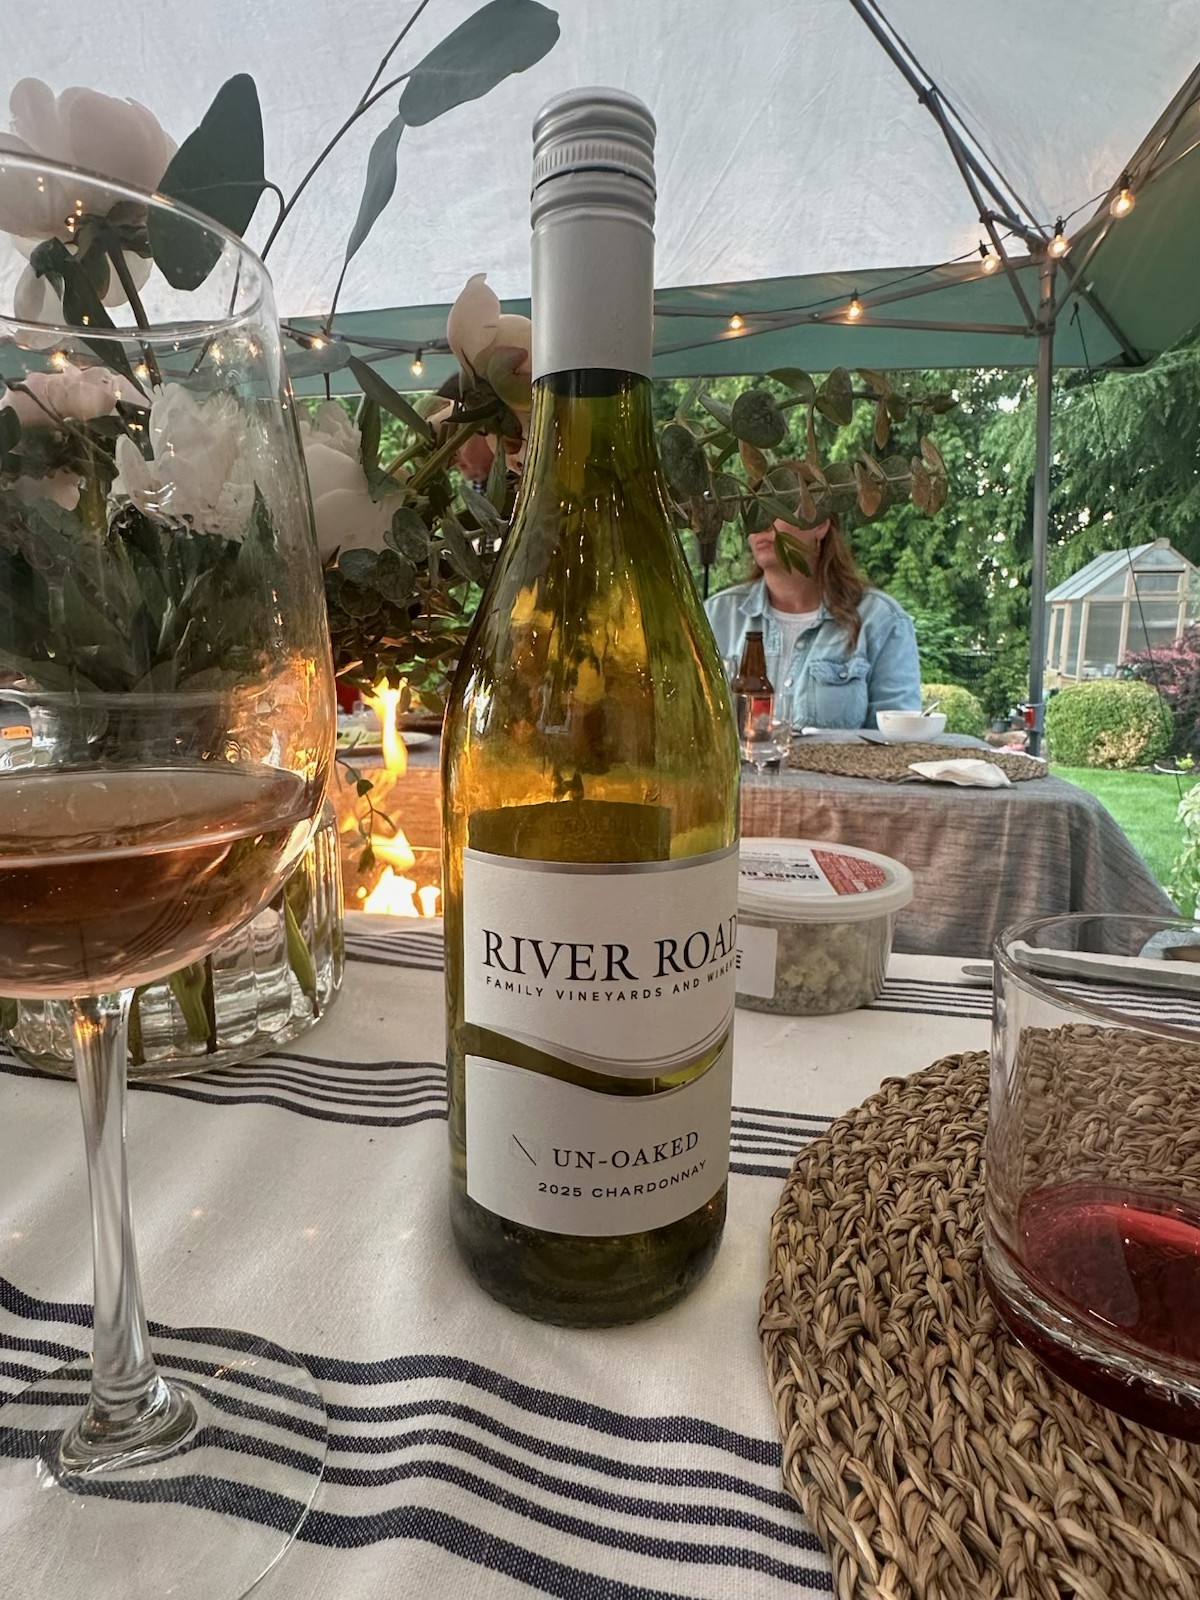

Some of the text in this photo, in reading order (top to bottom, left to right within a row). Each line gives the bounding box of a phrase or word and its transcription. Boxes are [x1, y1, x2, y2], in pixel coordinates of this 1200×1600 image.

[764, 872, 820, 880] DANSK
[481, 914, 737, 982] RIVER ROAD
[486, 976, 544, 997] FAMILY
[556, 987, 663, 1002] VINEYARDS
[672, 978, 700, 994] AND
[552, 1131, 699, 1169] UN-OAKED
[538, 1159, 707, 1198] 2025 CHARDONNAY
